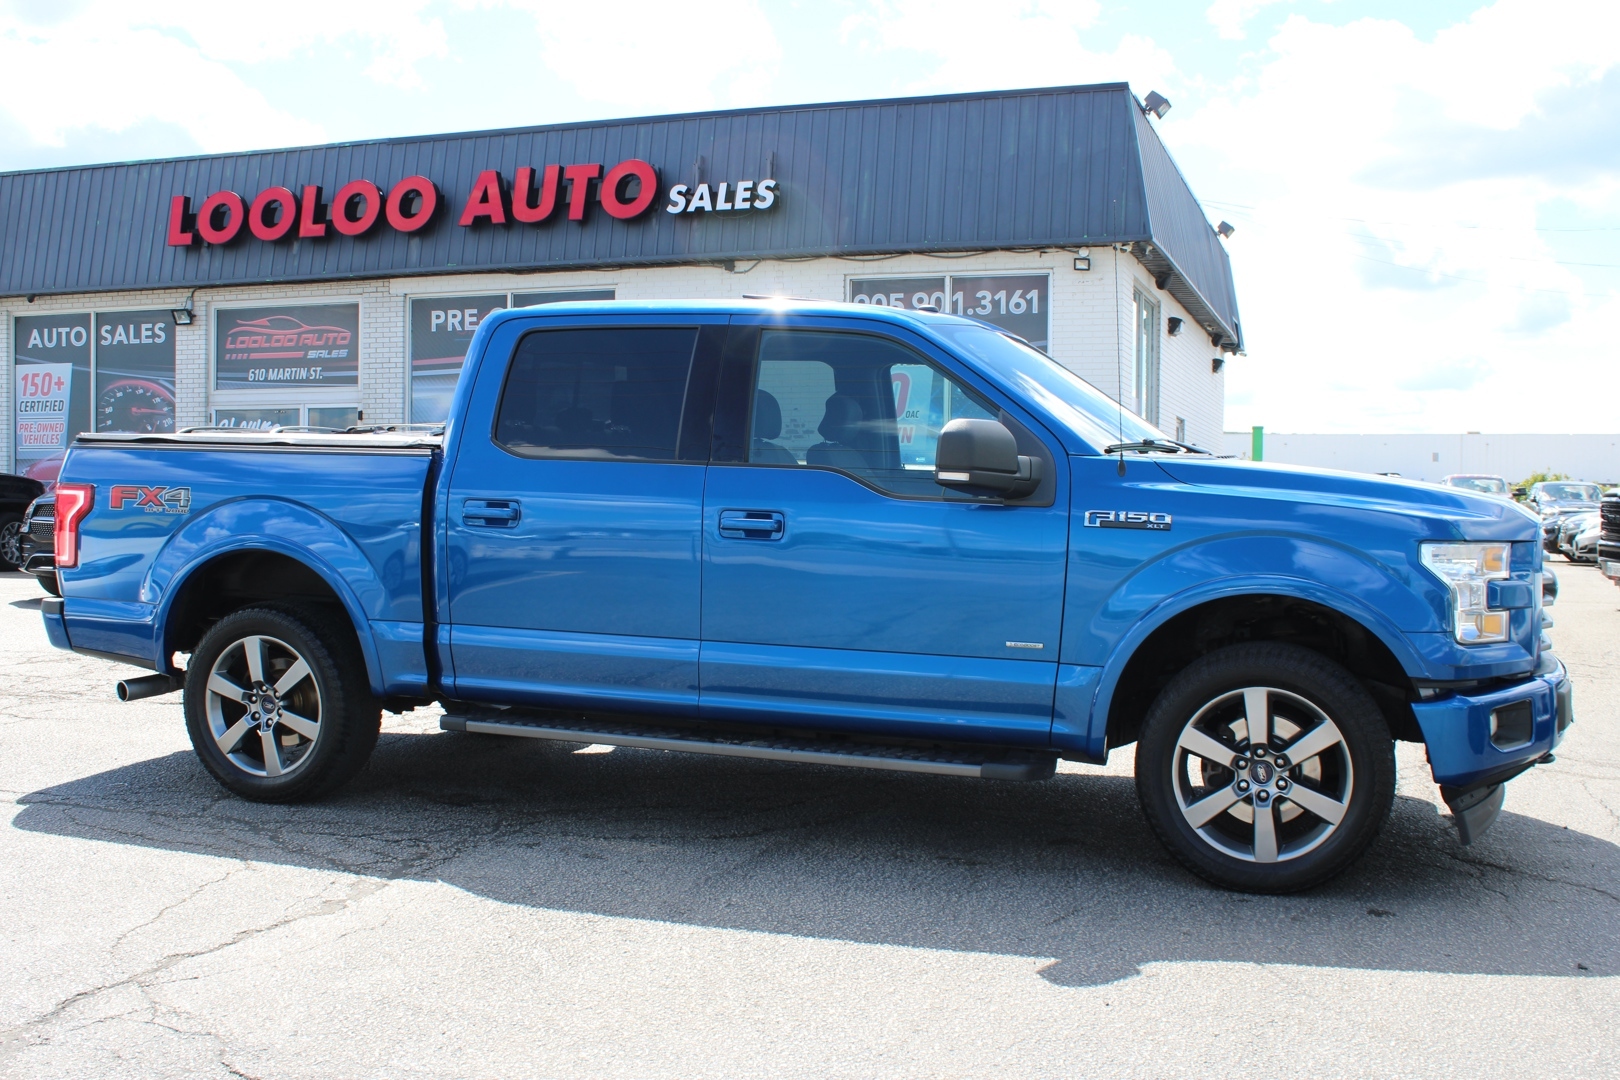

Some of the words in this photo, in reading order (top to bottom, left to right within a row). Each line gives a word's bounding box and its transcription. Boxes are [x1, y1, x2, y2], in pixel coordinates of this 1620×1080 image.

[167, 175, 439, 247] LOOLOO
[458, 158, 659, 227] AUTO
[666, 178, 778, 214] SALES
[853, 289, 1039, 316] 5901.3161
[27, 326, 87, 348] AUTO
[100, 322, 166, 346] SALES
[225, 334, 298, 349] LOOLOO
[298, 332, 351, 347] AUTO
[307, 349, 349, 359] SALES
[248, 368, 265, 381] 610
[267, 367, 307, 381] MARTIN
[309, 367, 323, 380] ST.
[21, 372, 65, 397] 150+
[19, 399, 65, 413] CERTIFIED
[905, 410, 919, 419] OAC
[18, 422, 65, 433] PRE-OWNED
[23, 434, 60, 445] VEHICLES
[109, 485, 191, 510] FX4
